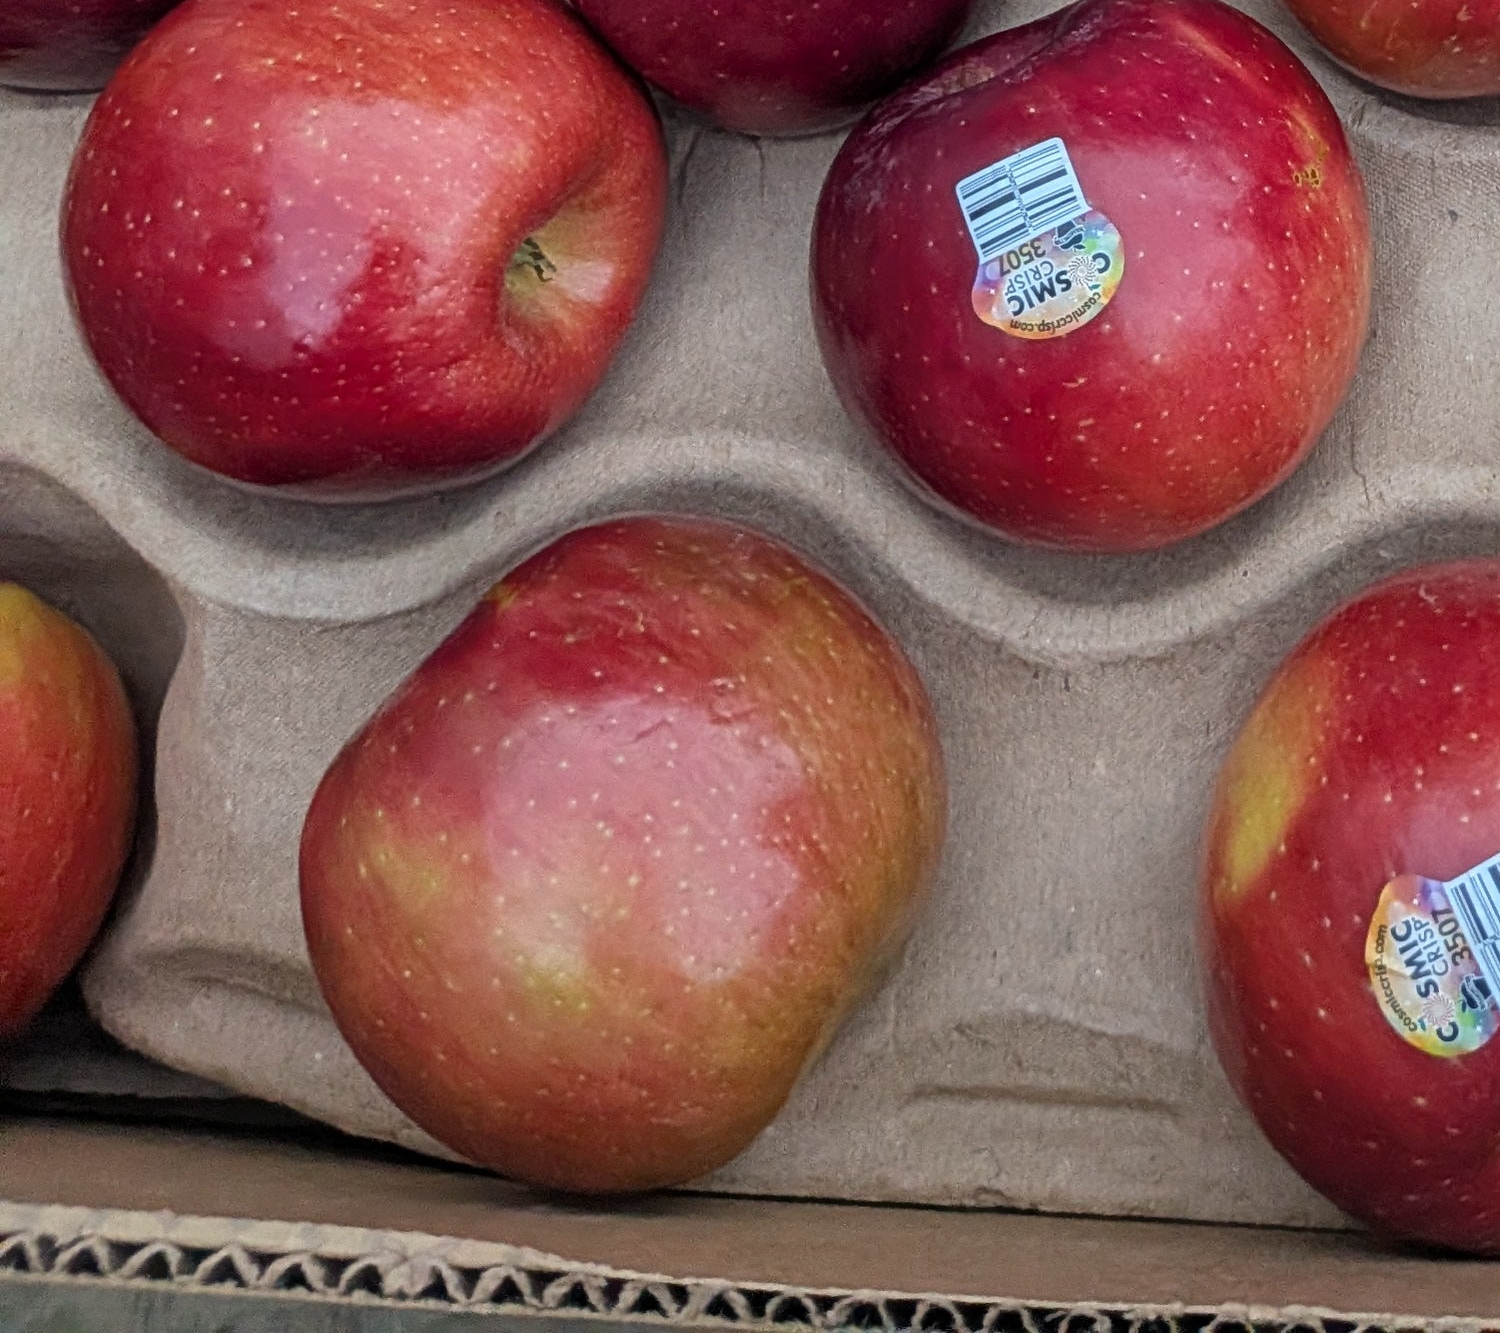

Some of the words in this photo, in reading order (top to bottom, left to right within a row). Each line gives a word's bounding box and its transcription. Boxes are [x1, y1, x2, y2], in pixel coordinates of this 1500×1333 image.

[999, 238, 1047, 277] 3507
[1009, 292, 1101, 333] cosmiccrisp.com
[1431, 907, 1473, 966] 3507
